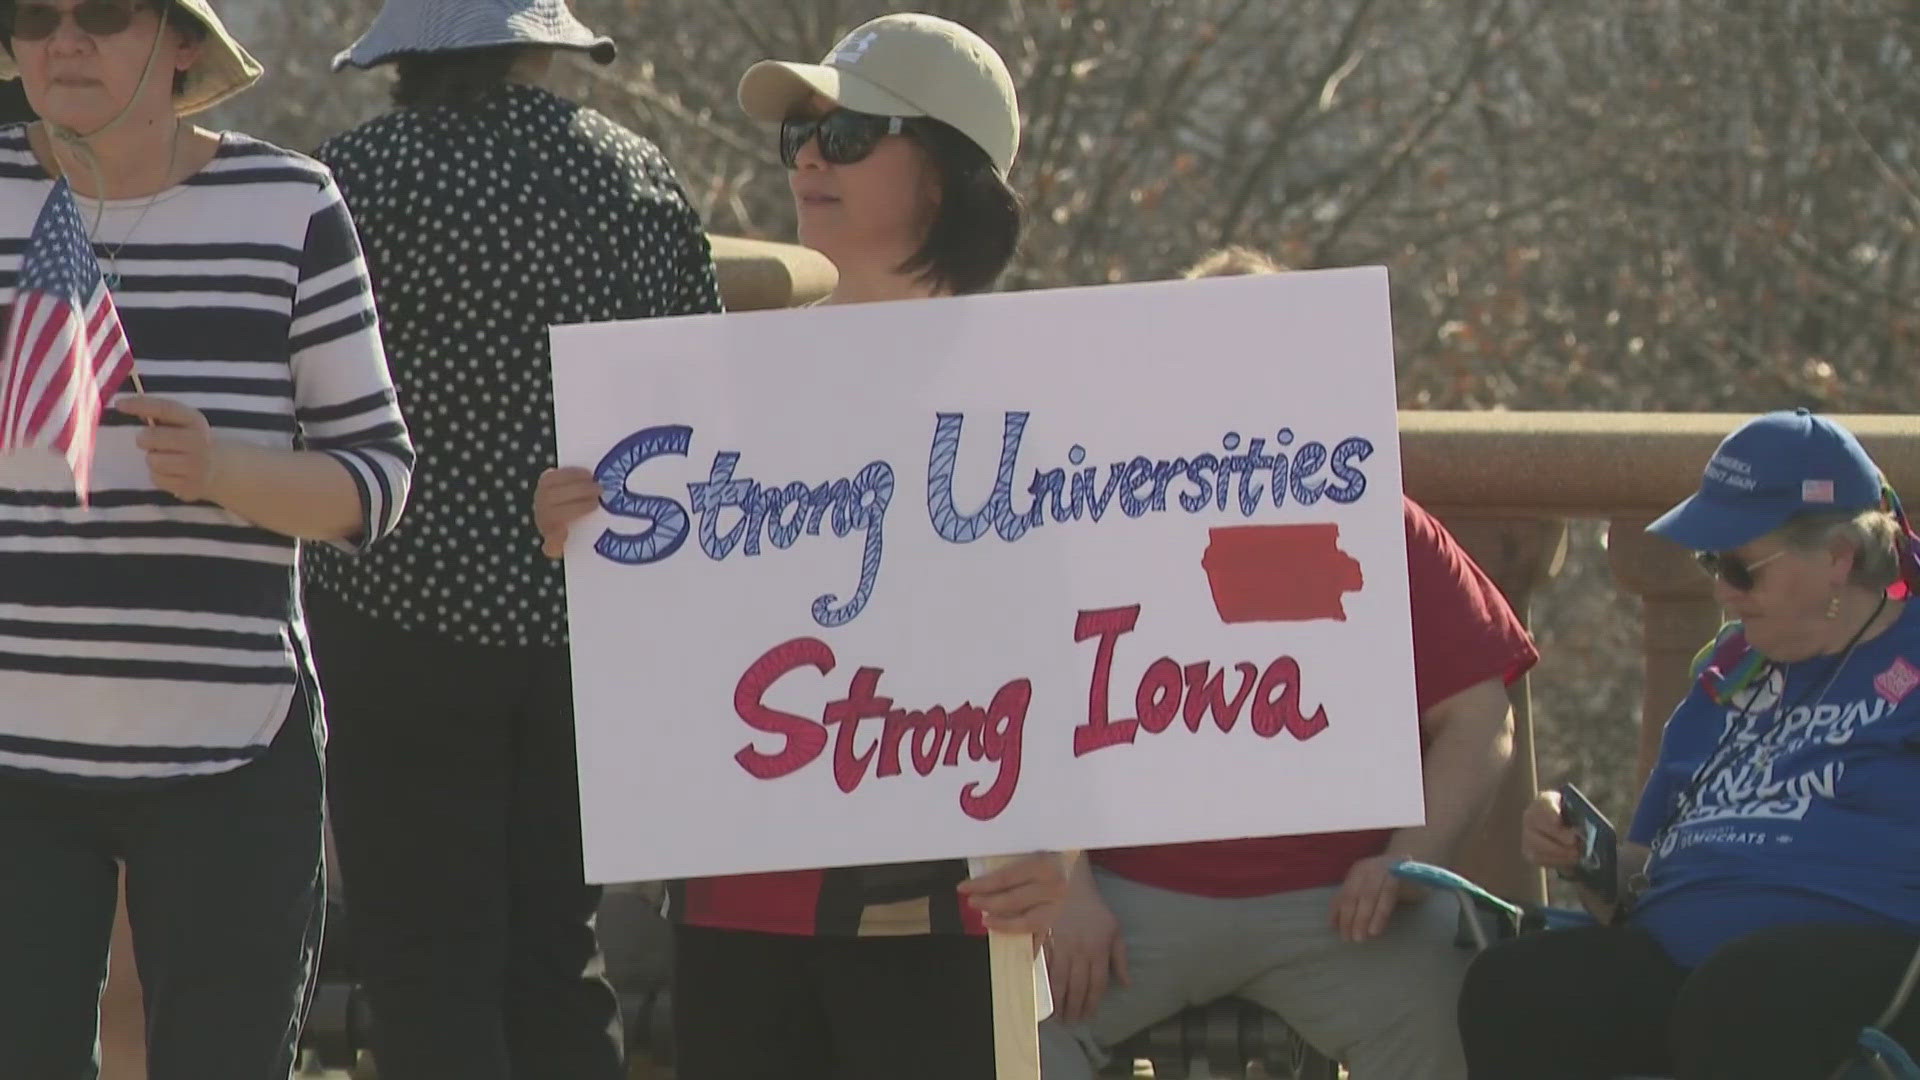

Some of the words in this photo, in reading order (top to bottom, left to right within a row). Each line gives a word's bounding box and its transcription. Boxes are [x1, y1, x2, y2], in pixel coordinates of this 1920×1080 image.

[594, 424, 895, 627] Strong
[927, 411, 1374, 544] Universities
[733, 636, 1033, 822] Strong
[1073, 604, 1330, 758] Iowa
